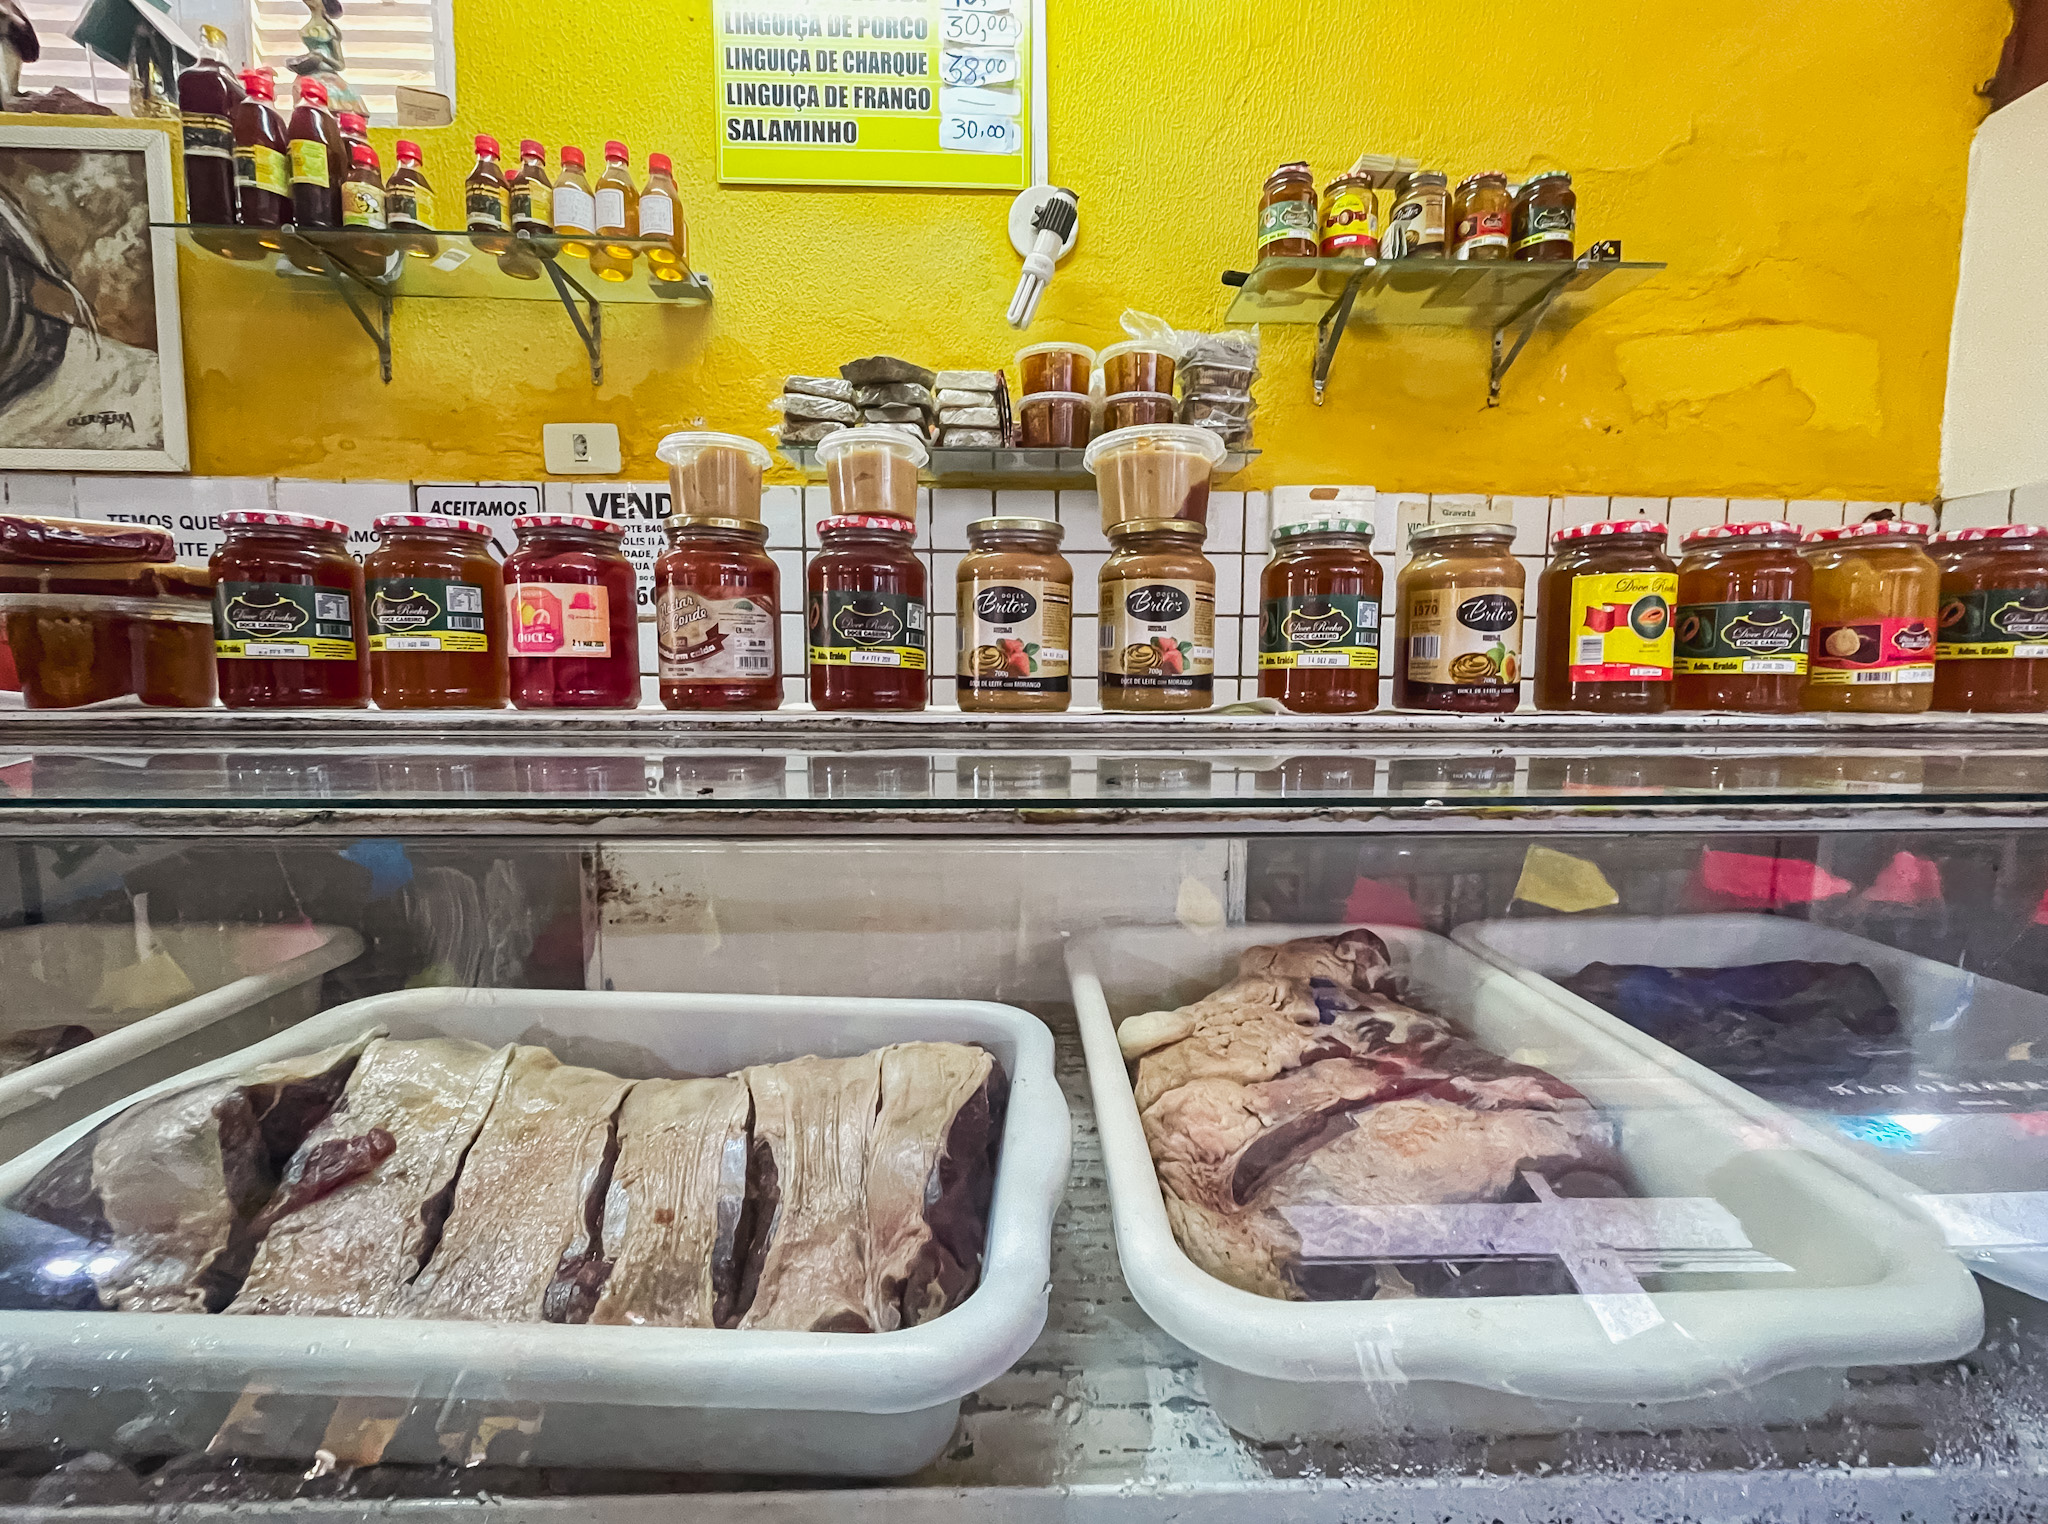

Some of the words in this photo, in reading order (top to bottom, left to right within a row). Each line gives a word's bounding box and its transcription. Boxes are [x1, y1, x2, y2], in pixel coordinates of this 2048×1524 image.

[725, 12, 822, 41] LINGUIÇA
[827, 15, 852, 38] DE
[858, 15, 928, 40] PORCO
[946, 13, 1008, 42] 30,00
[725, 47, 811, 76] LINGUIÇA
[816, 50, 838, 72] DE
[842, 51, 927, 77] CHARQUE
[944, 52, 1007, 85] 38,00
[727, 83, 820, 112] LINGUIÇA
[825, 85, 848, 108] DE
[854, 86, 931, 110] FRANGO
[728, 118, 857, 143] SALAMINHO
[951, 118, 1005, 139] 30,00
[431, 501, 527, 516] ACEITAMOS
[620, 550, 654, 559] DADE,
[1614, 577, 1649, 593] Doce
